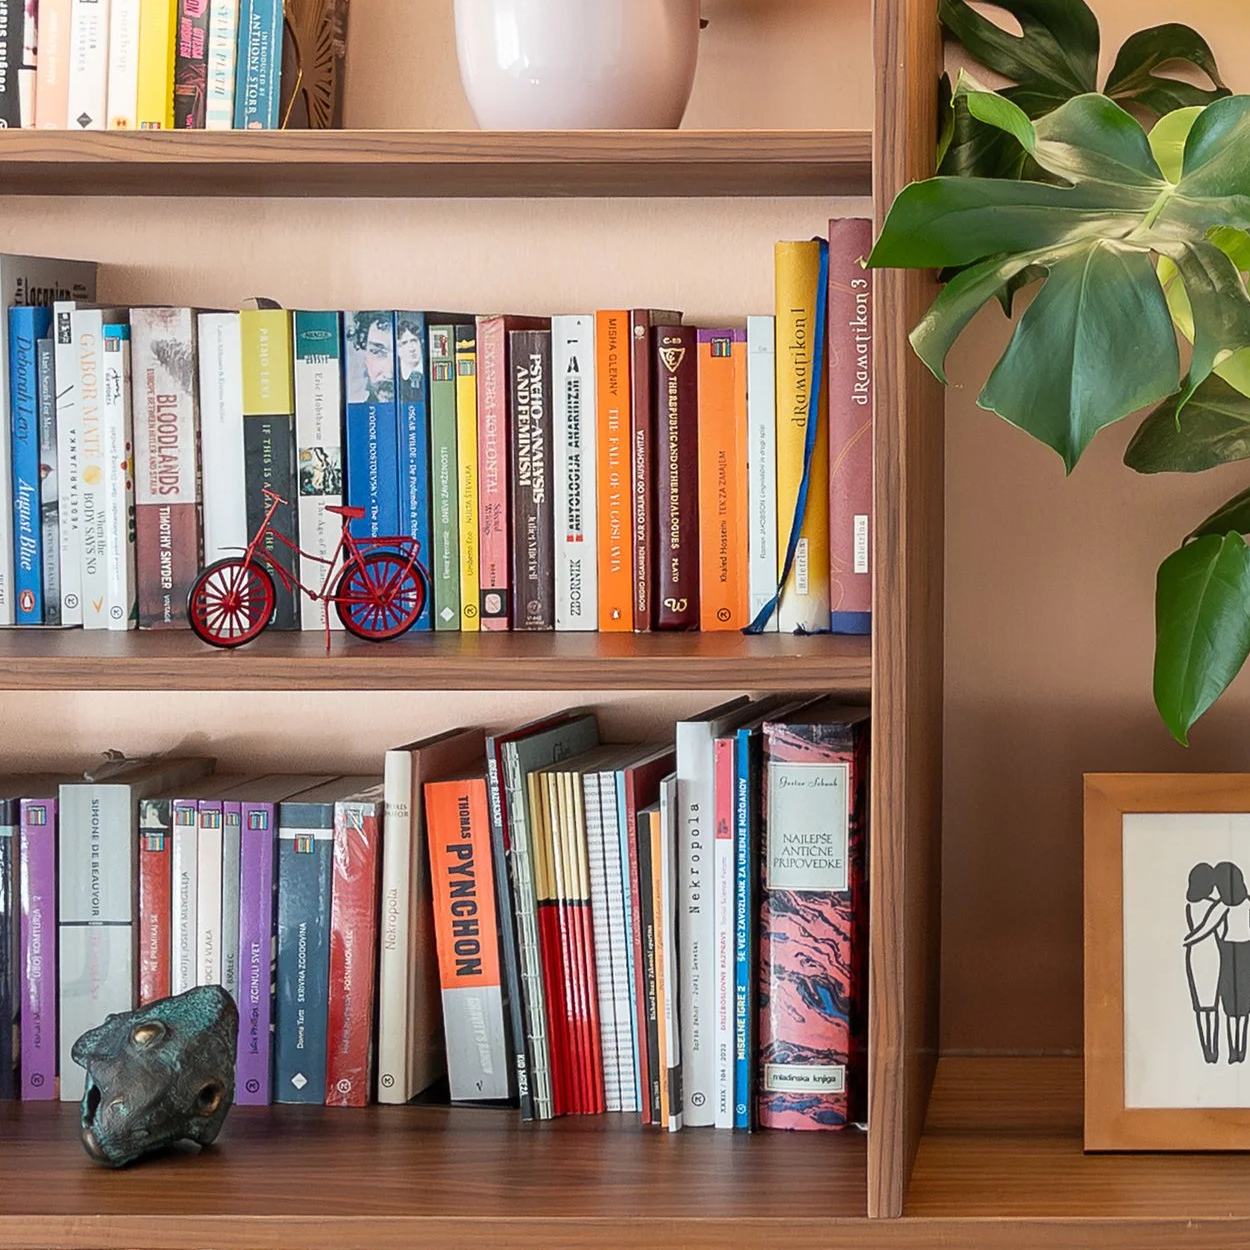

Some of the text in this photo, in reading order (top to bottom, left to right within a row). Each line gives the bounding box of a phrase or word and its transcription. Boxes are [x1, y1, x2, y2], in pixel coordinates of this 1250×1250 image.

[247, 13, 262, 114] ANTHONY STORR
[852, 278, 868, 288] 3
[16, 336, 34, 404] Deborah
[79, 333, 95, 400] GABOR
[258, 327, 270, 399] PRIMO LEVI
[314, 372, 324, 390] Eric
[608, 318, 618, 396] MISHA GLENNY
[155, 393, 179, 496] BLOODLANDS
[262, 424, 272, 478] IF THIS IS
[408, 405, 417, 458] OSCAR WILDE
[518, 404, 531, 486] FEMINISM
[529, 353, 545, 503] PSYCHO-ANALYSIS
[636, 429, 646, 480] AUSCHWITZA
[608, 437, 621, 573] FALL YUGOSLAVIA
[637, 480, 646, 494] OD
[637, 494, 646, 524] OSTAJA
[17, 478, 39, 571] August Blue
[83, 492, 97, 575] BODY SAYS NO
[157, 506, 172, 589] TIMOTHY SNYDER
[567, 454, 582, 616] ZBORNIK ANTOLOGIJA
[637, 524, 646, 541] KAR
[719, 520, 728, 583] Khaled Hosseini
[639, 546, 647, 581] AGAMBEN
[671, 557, 680, 582] PLATO
[455, 794, 471, 839] THOMAS
[782, 833, 833, 845] NAJLEPŠE
[91, 798, 100, 916] SIMONE DE BEAUVOIR
[688, 802, 704, 914] Nekropola
[736, 867, 748, 878] ZA
[773, 857, 842, 869] PRIPOVEDKE
[781, 845, 834, 857] ANTIČNE
[384, 887, 398, 951] Nekropola
[445, 842, 484, 977] PYNCHON
[737, 994, 748, 1017] IGRE
[736, 1018, 748, 1060] MISELNE
[812, 1072, 837, 1084] knjiga
